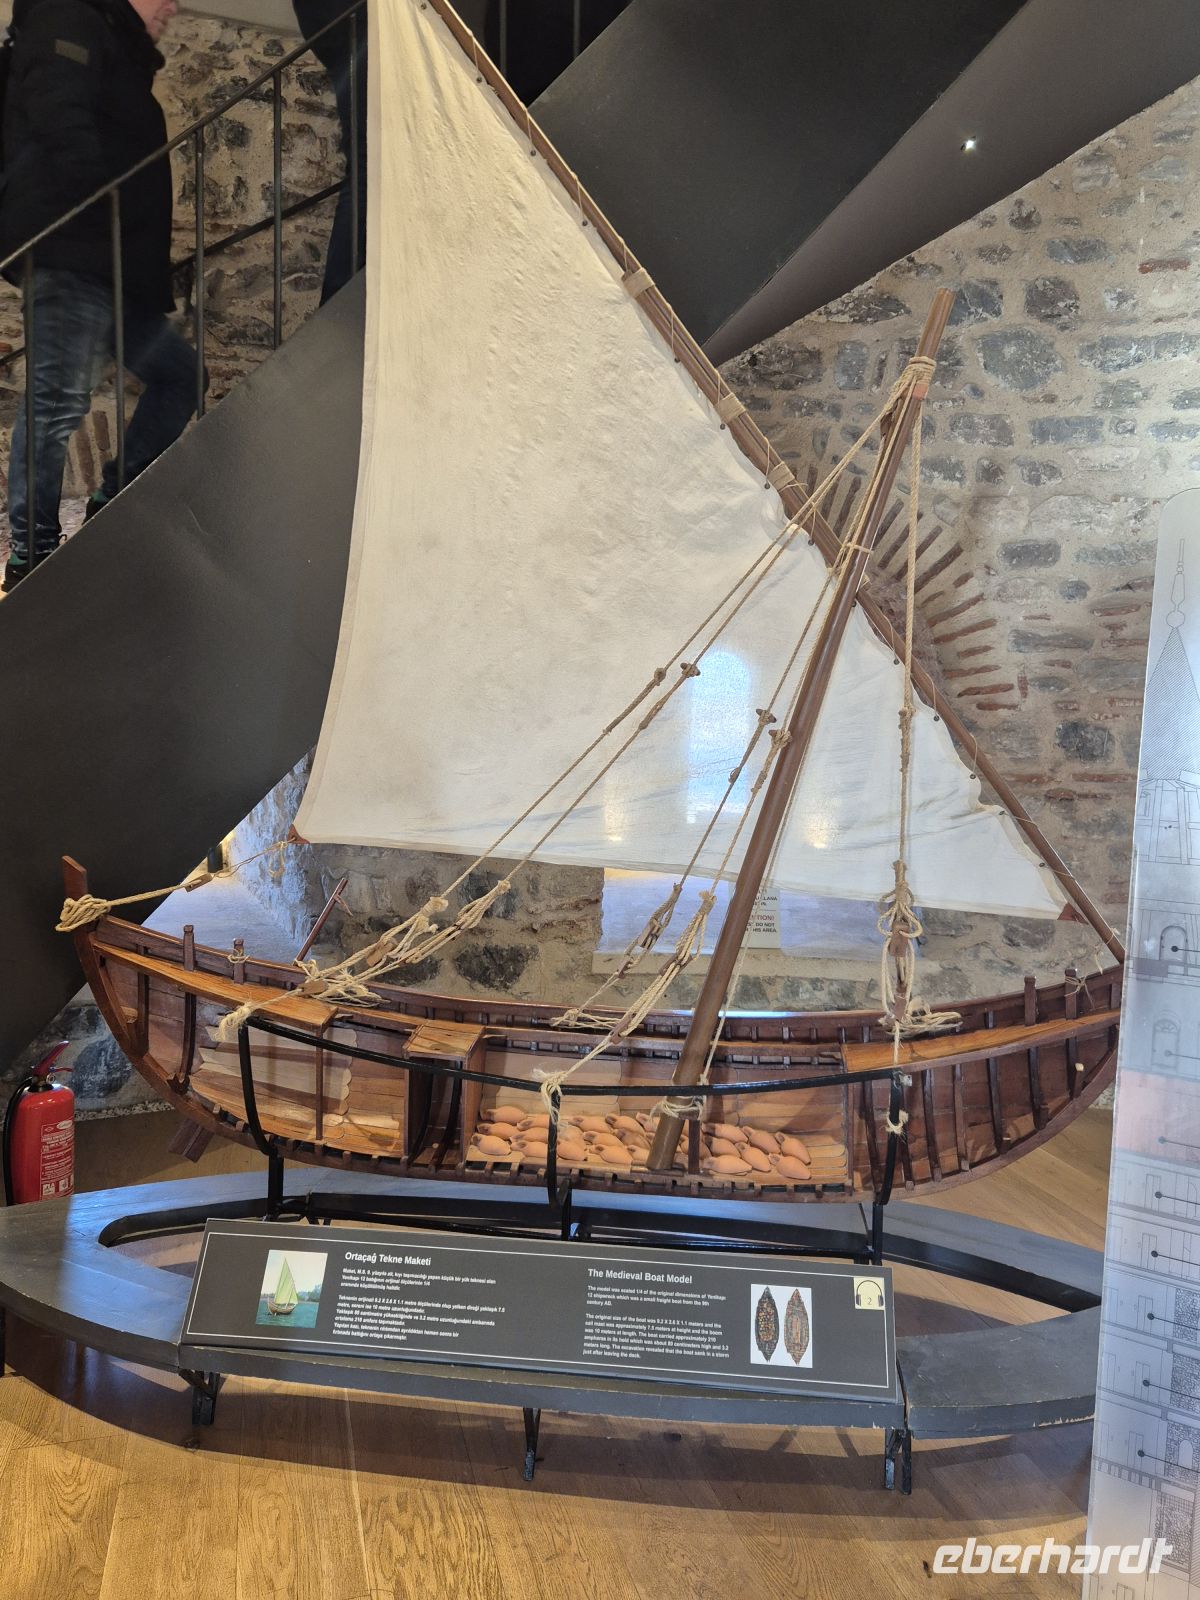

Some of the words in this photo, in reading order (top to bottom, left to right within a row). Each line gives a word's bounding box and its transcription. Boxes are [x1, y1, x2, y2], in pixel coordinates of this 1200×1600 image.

[345, 1252, 377, 1263] Ortaçağ
[378, 1254, 403, 1263] Tekne
[404, 1256, 431, 1265] Maketi
[588, 1268, 604, 1276] The
[606, 1269, 643, 1279] Medieval
[645, 1272, 664, 1281] Boat
[667, 1274, 692, 1283] Model
